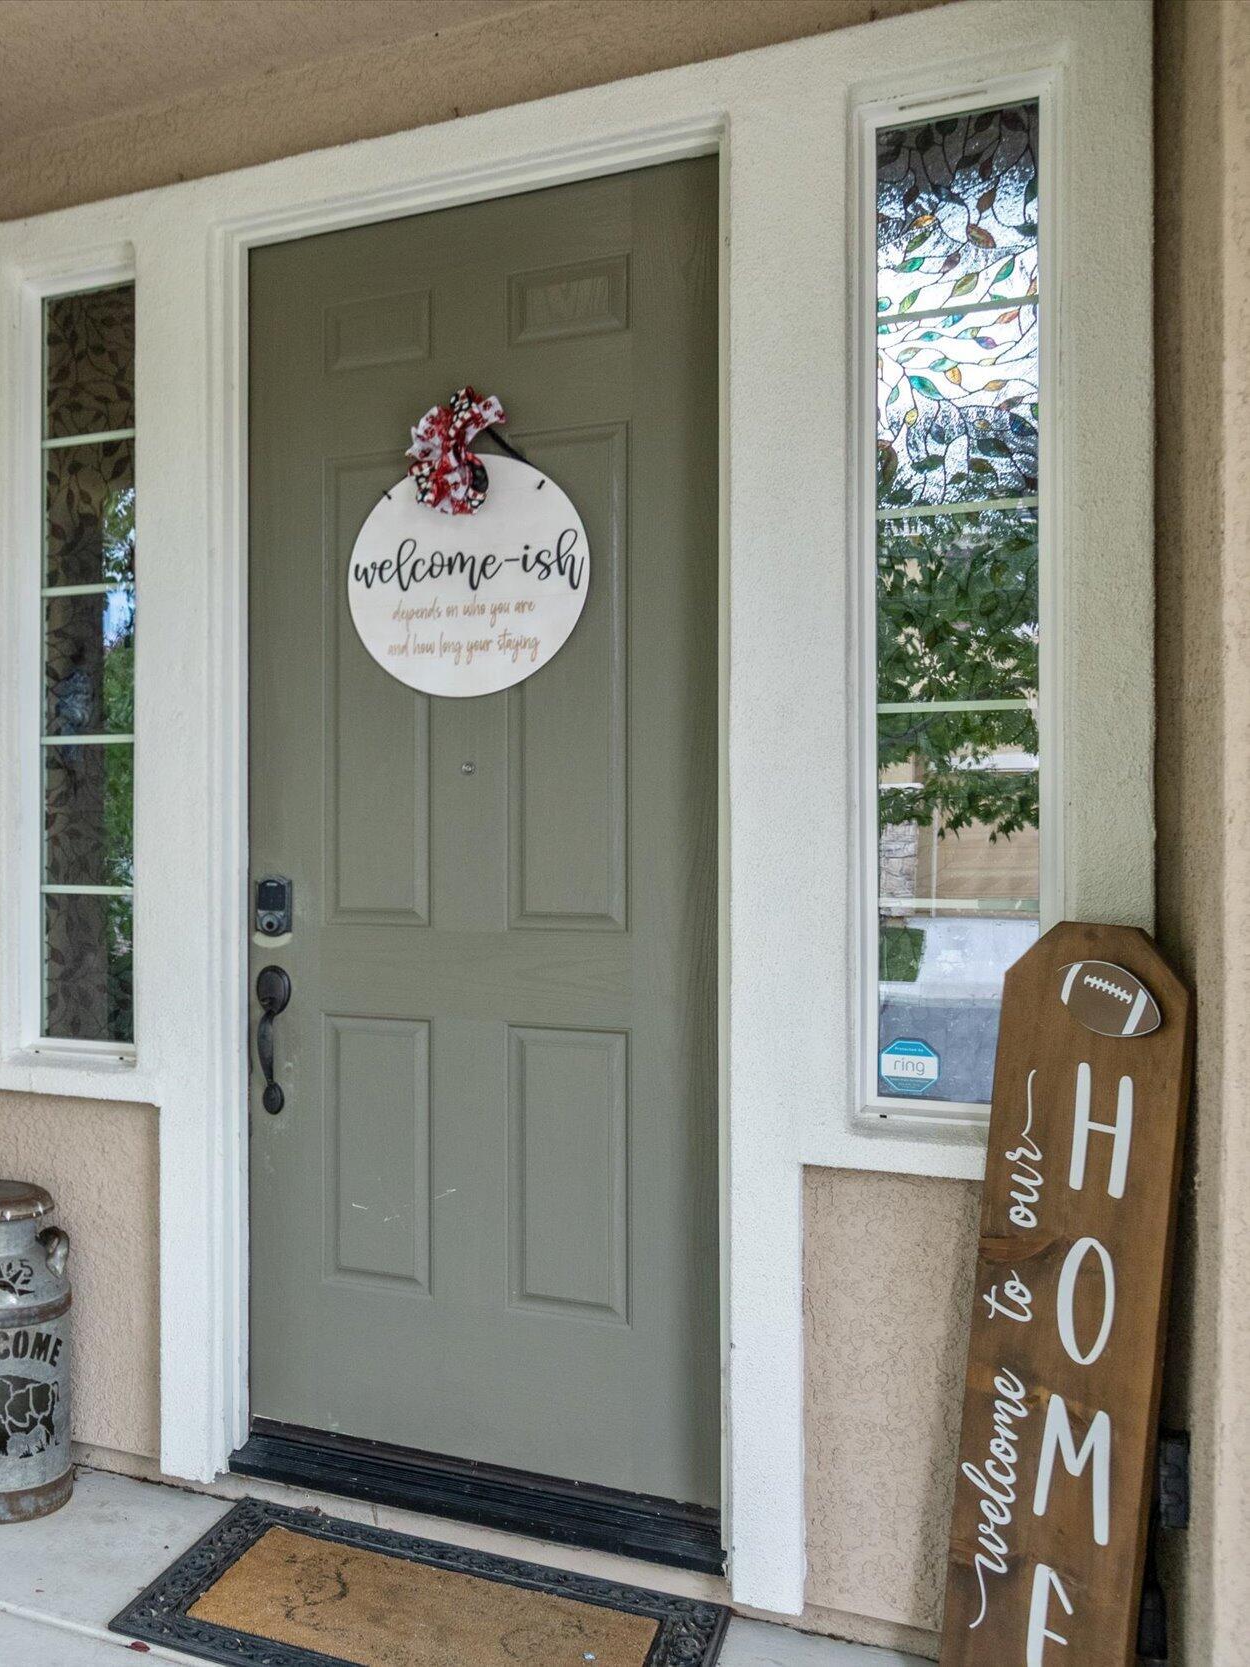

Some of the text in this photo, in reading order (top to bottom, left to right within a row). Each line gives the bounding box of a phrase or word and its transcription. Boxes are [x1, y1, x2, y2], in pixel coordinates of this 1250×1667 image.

[354, 528, 585, 592] welcome-ish
[392, 594, 536, 632] depends on who you are
[387, 628, 541, 665] and how long your staying
[894, 1057, 925, 1076] ring
[961, 1069, 1044, 1628] welcome to our
